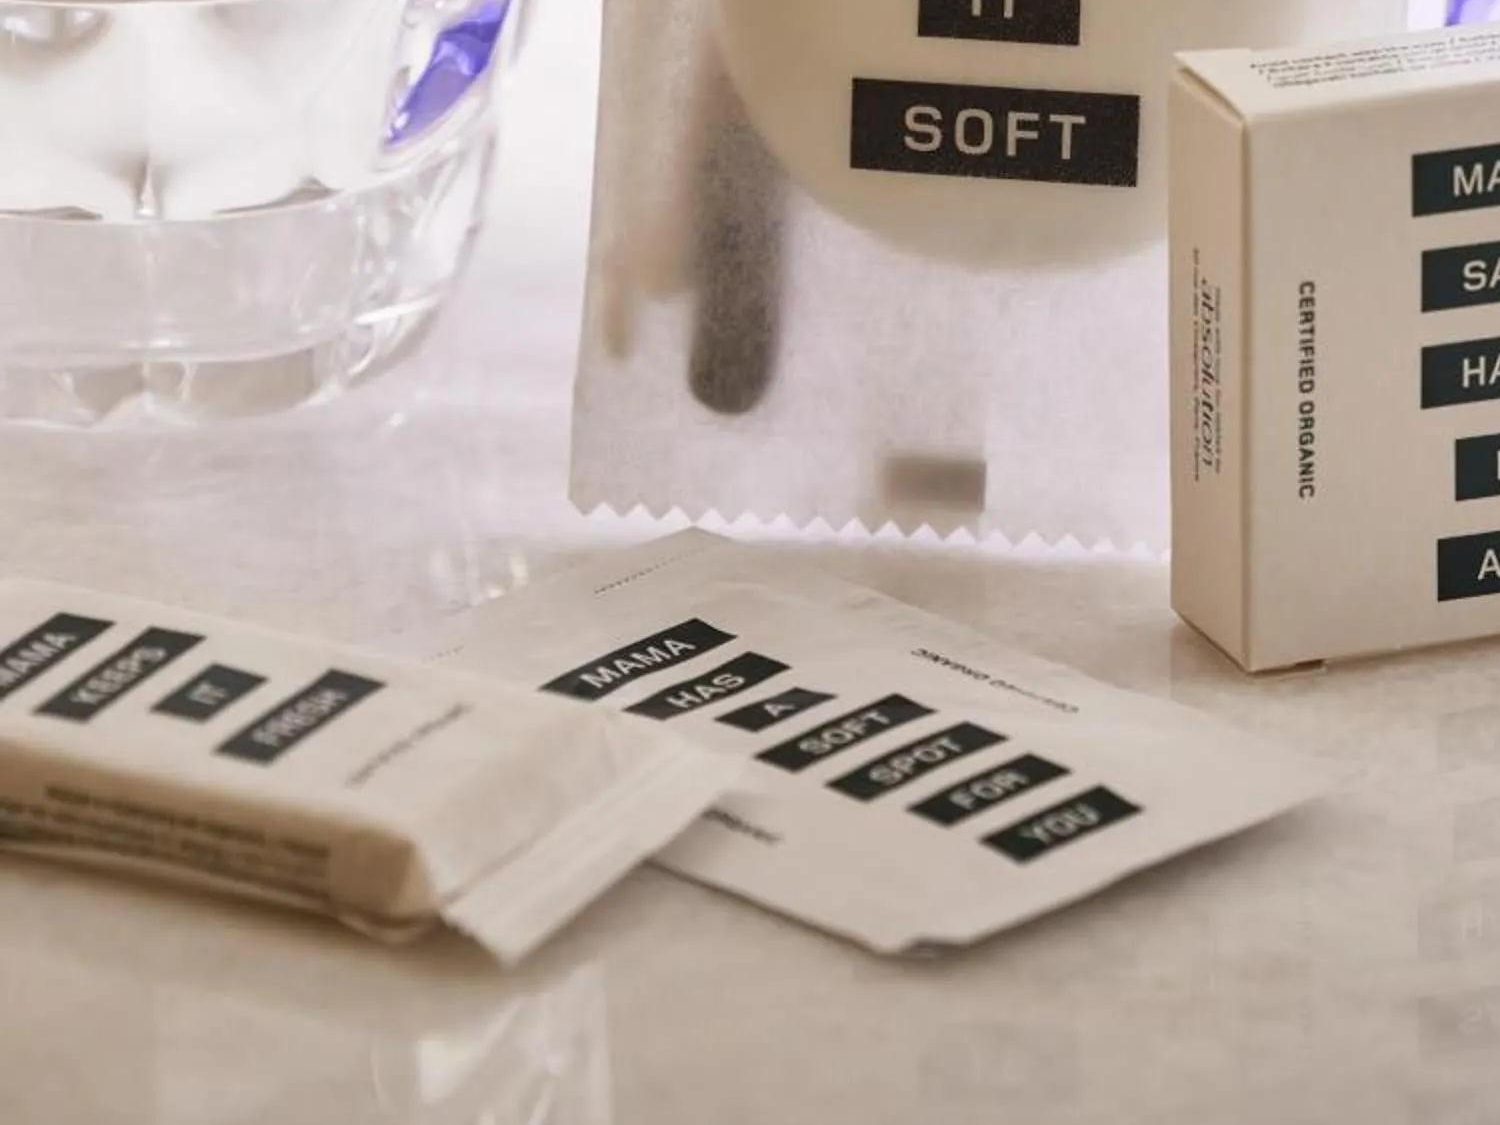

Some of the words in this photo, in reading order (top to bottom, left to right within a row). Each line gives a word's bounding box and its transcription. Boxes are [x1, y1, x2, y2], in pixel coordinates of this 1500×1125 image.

[904, 106, 1086, 160] SOFT
[1299, 281, 1315, 393] CERTIFIED
[1299, 400, 1315, 499] ORGANIC
[68, 646, 167, 704] KEEPS
[580, 638, 696, 688] MAMA
[187, 681, 228, 706] IT
[667, 673, 745, 708] HAS
[763, 701, 796, 717] A
[798, 710, 890, 754] SOFT
[869, 736, 962, 785] SPOT
[949, 770, 1030, 809] FOR
[1018, 802, 1101, 843] YOU
